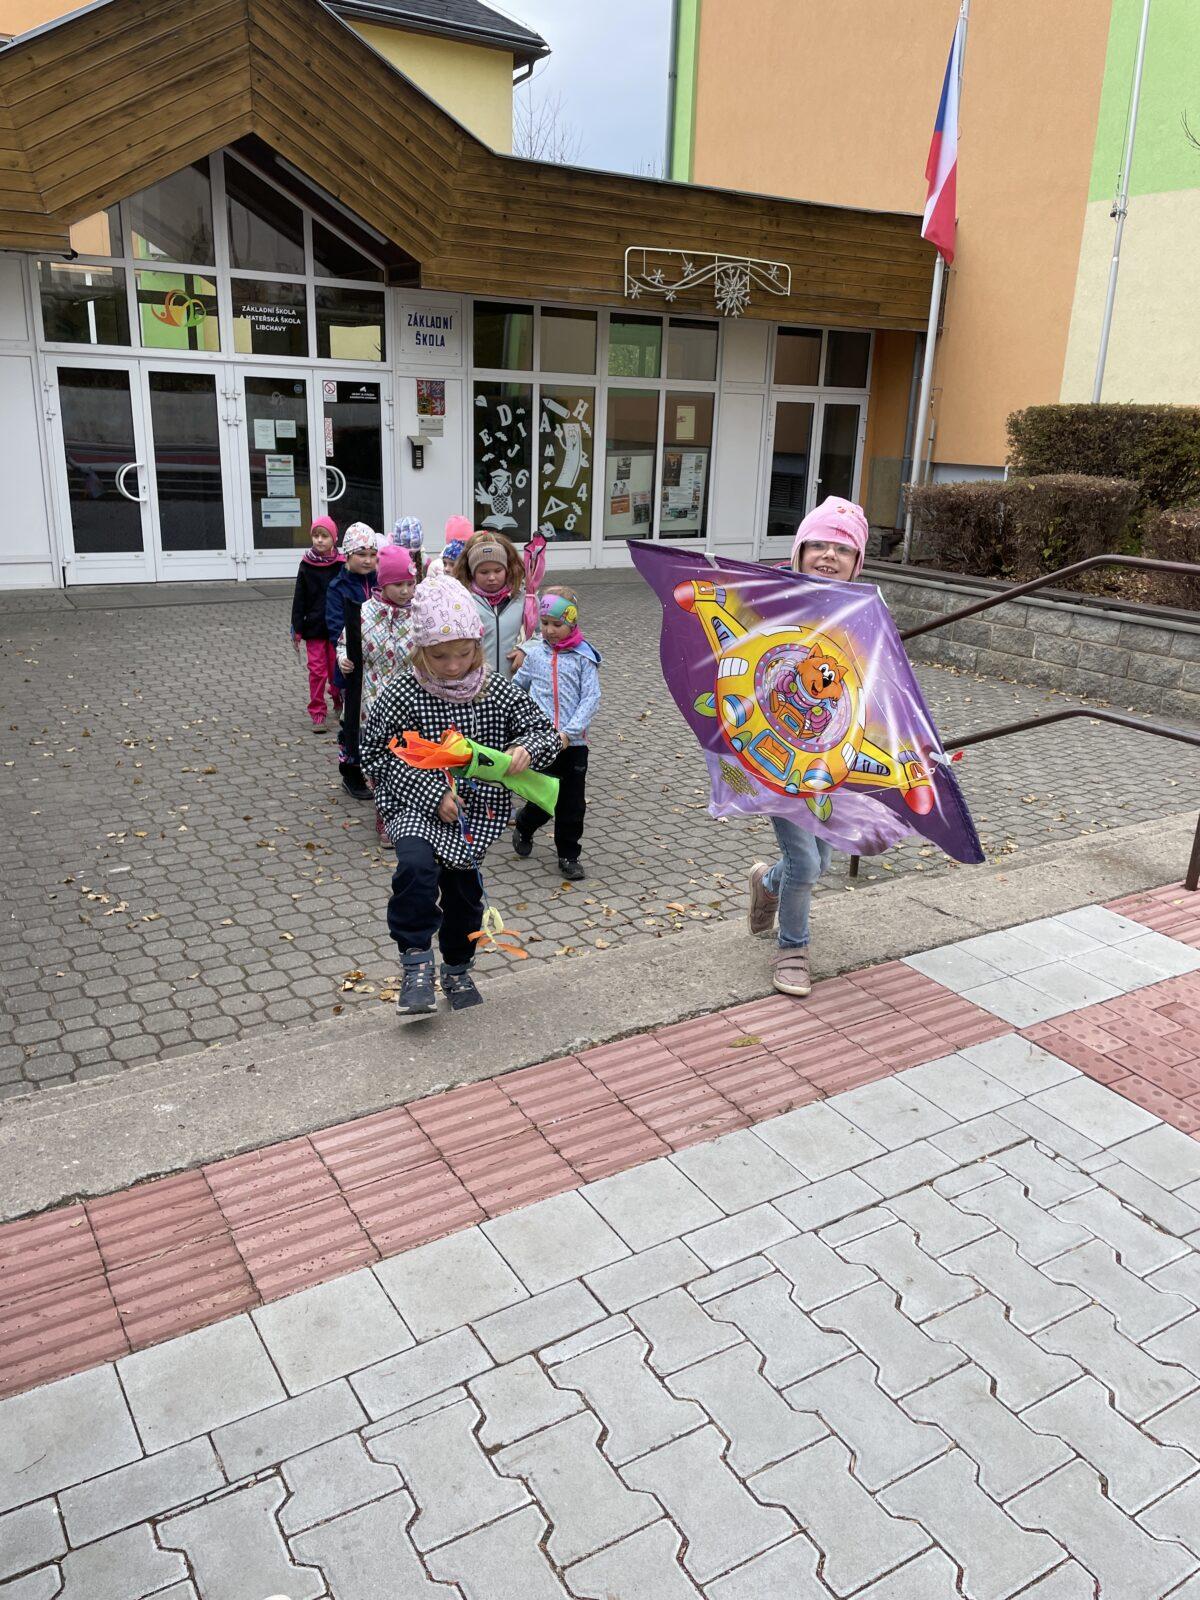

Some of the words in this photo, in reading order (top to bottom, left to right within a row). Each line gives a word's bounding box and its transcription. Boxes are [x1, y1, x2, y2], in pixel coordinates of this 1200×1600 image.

[242, 305, 274, 314] ZÁKLADNÍ
[275, 307, 296, 315] ŠKOLA
[245, 315, 280, 323] MATEŘSKÁ
[407, 312, 453, 330] ZÁKLADNÍ
[415, 330, 446, 347] ŠKOLA
